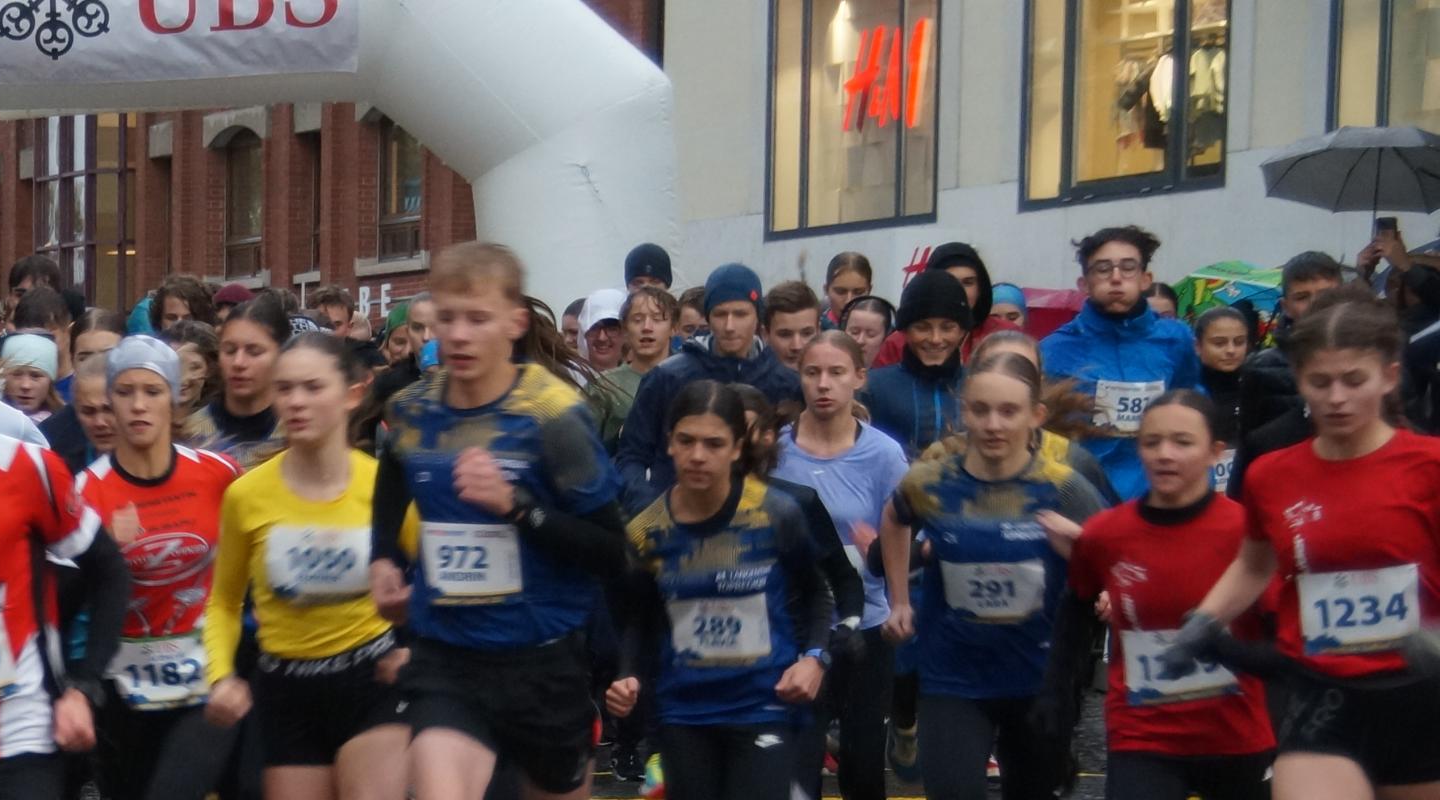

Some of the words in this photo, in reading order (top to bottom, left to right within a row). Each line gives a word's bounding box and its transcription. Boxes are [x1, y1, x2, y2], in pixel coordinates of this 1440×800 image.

[1116, 397, 1149, 413] 58
[437, 544, 490, 570] 972
[968, 579, 1017, 598] 291
[1313, 591, 1409, 630] 1234
[123, 657, 203, 689] 1182
